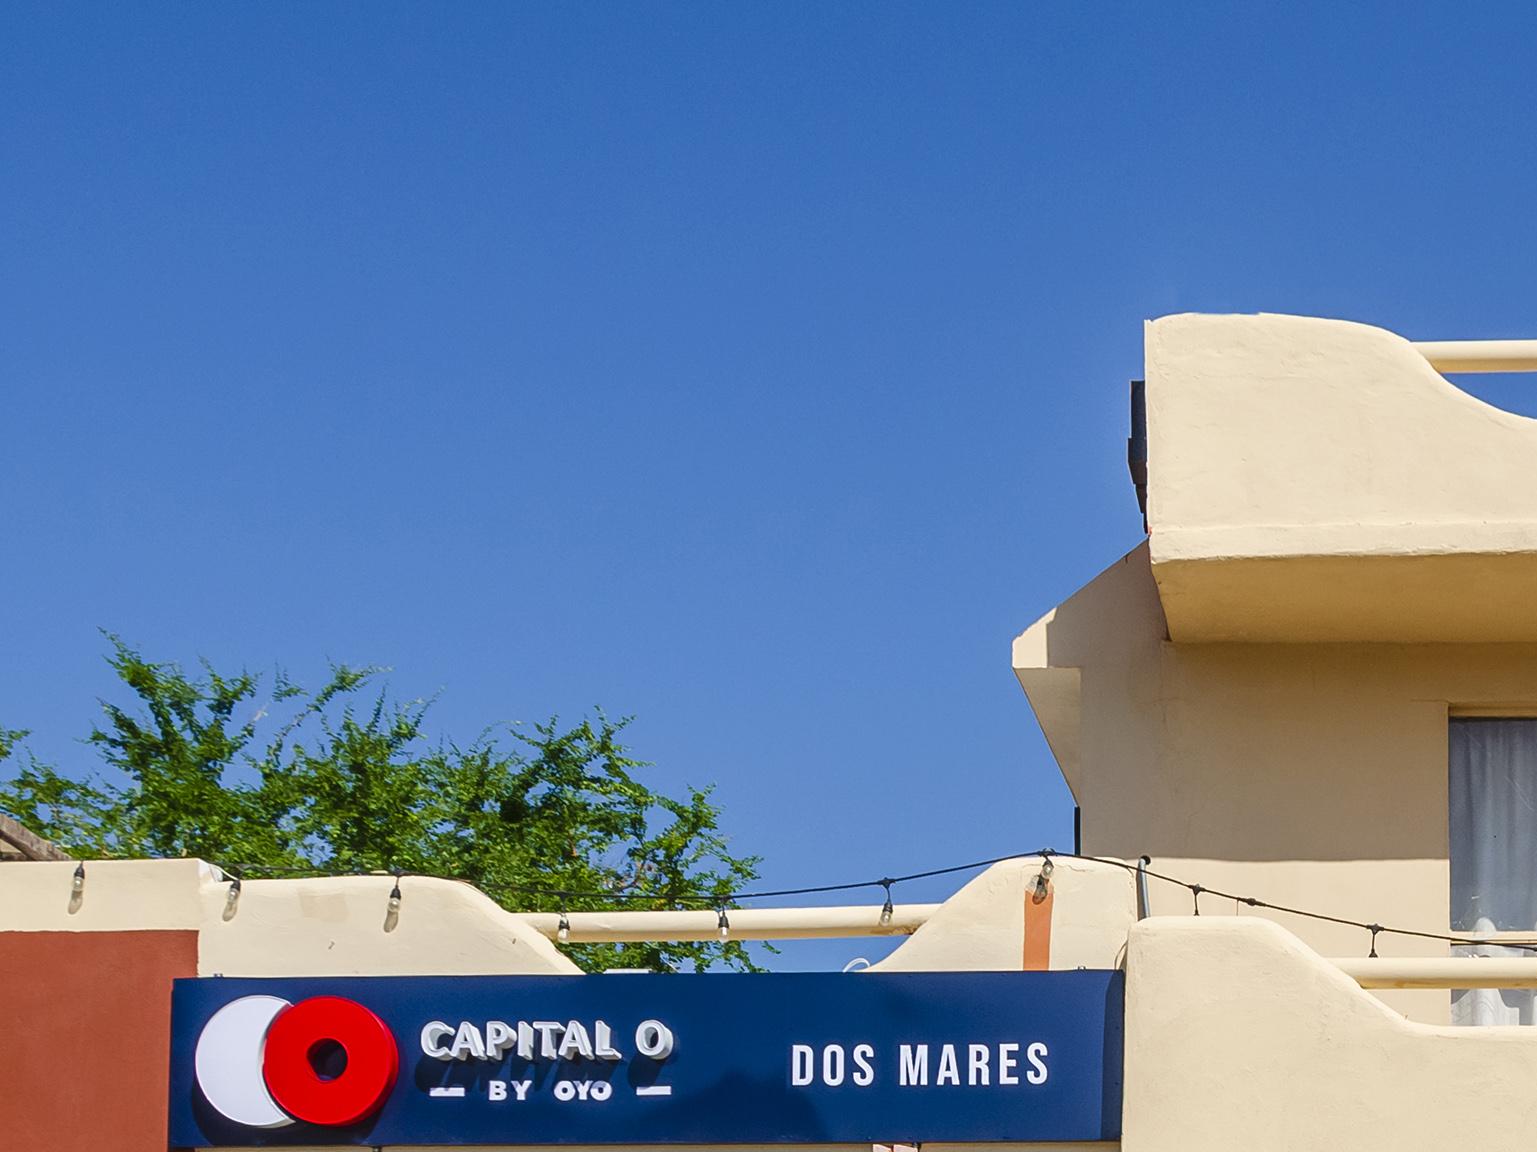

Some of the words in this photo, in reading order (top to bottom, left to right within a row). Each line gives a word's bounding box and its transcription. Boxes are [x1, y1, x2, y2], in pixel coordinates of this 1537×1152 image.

[421, 1020, 622, 1061] CAPITAL
[635, 1019, 673, 1059] O
[791, 1043, 875, 1087] DOS
[899, 1042, 1049, 1086] MARES
[489, 1080, 532, 1100] BY
[554, 1080, 612, 1100] OYO
